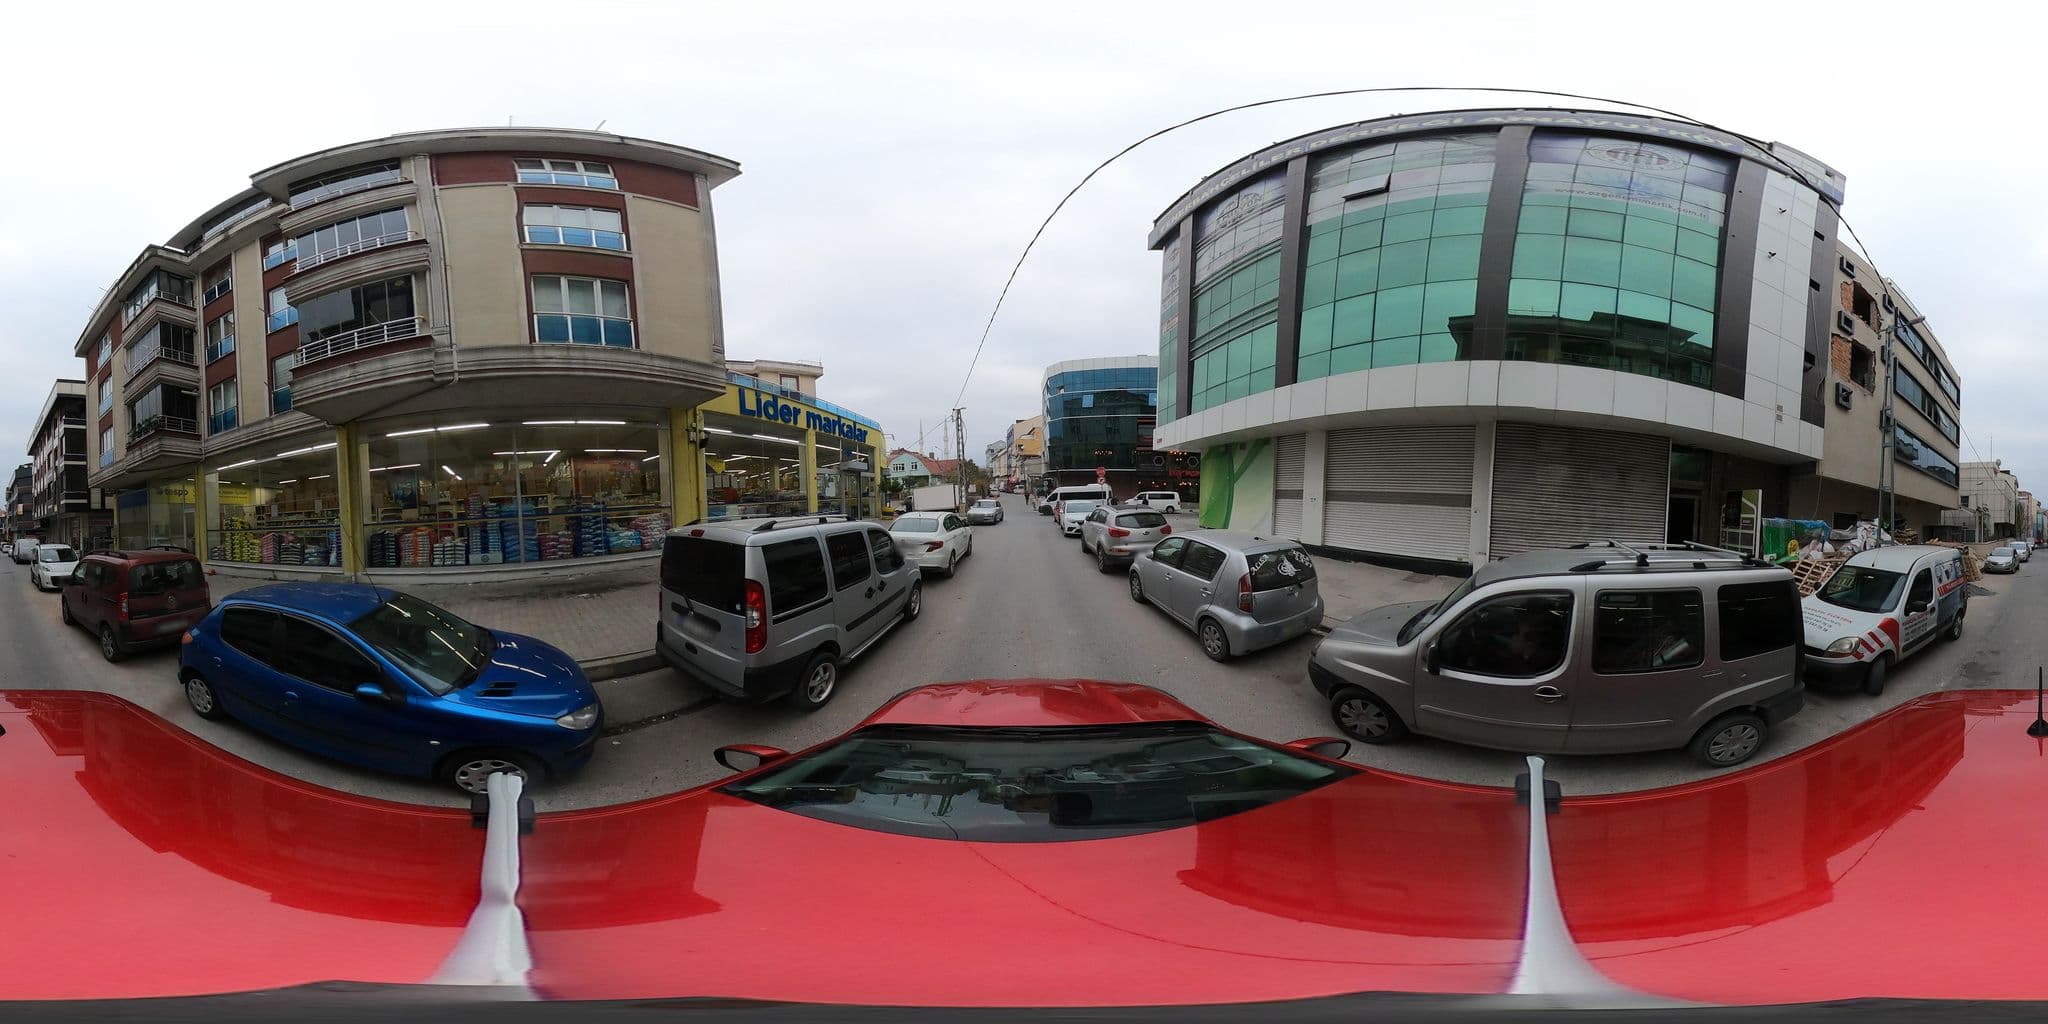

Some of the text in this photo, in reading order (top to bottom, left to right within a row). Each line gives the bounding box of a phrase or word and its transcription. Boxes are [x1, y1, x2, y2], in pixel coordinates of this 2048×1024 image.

[1477, 116, 1735, 148] ARNAVUTKÖY
[739, 387, 868, 443] Lider markalar
